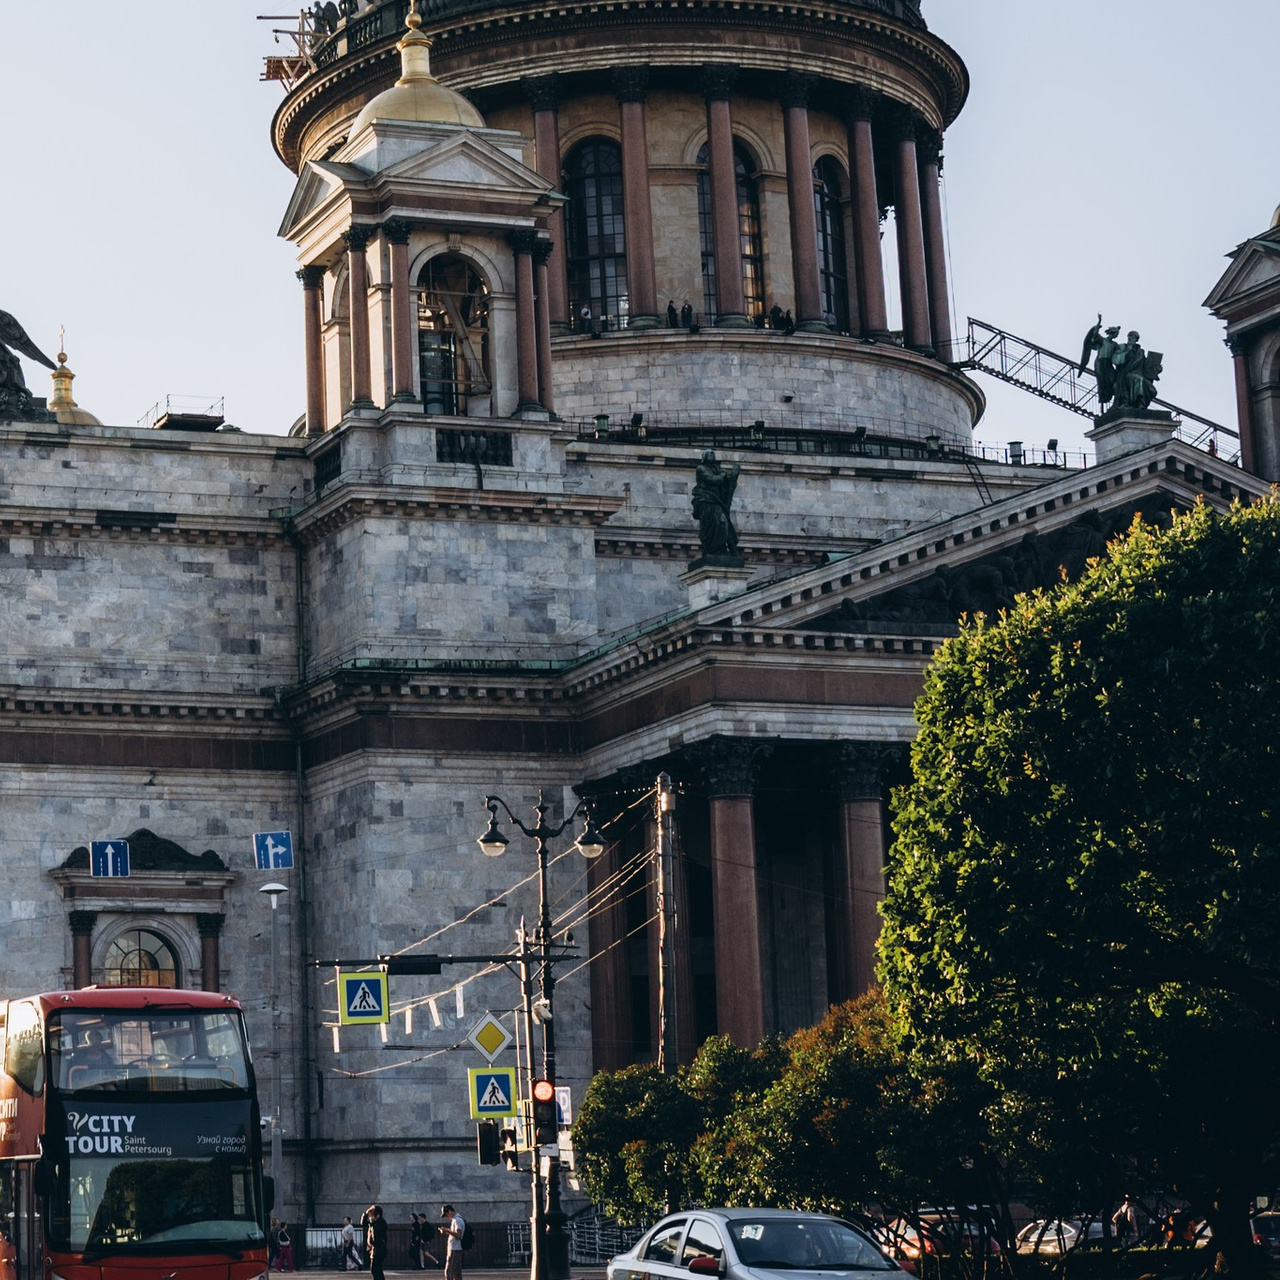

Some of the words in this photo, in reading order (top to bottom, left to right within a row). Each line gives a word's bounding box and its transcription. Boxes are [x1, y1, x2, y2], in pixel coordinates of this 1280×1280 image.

[88, 1115, 136, 1133] CITY
[65, 1136, 124, 1153] TOUR
[124, 1136, 146, 1145] Saint
[197, 1134, 221, 1144] Узнай
[222, 1135, 246, 1146] город
